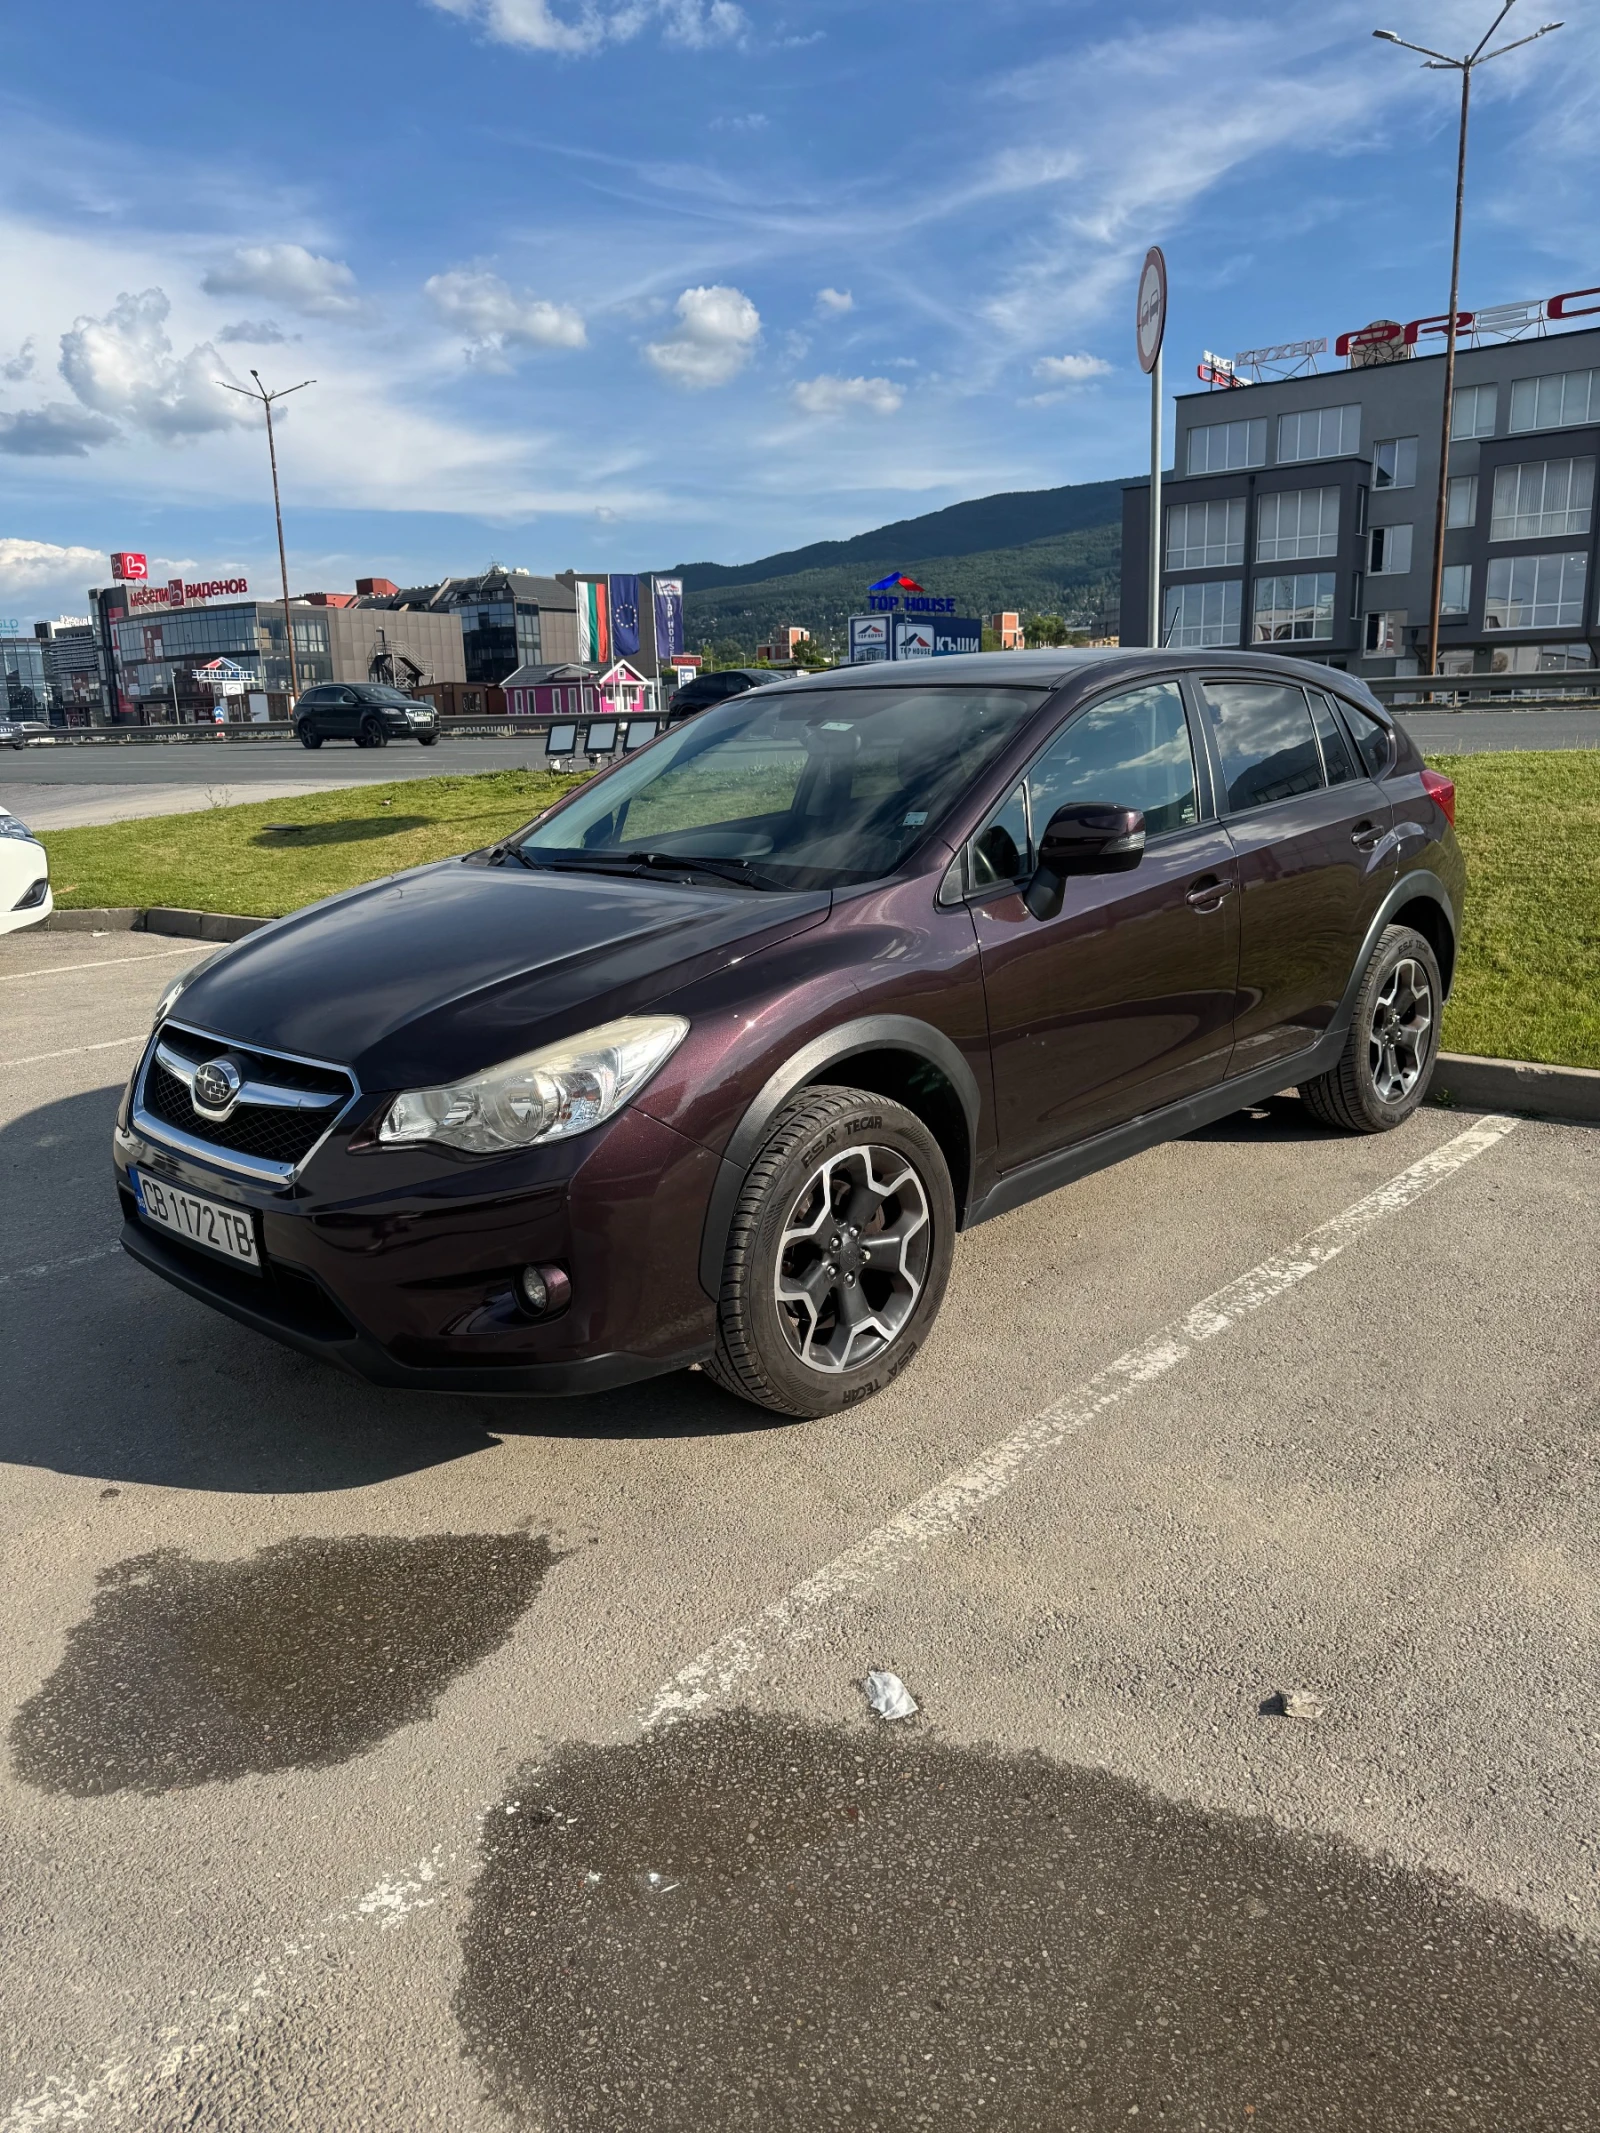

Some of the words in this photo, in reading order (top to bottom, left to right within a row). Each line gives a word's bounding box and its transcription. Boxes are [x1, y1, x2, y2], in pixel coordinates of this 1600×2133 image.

[1235, 337, 1327, 367] КУХНИ
[867, 595, 899, 611] TOP
[903, 596, 956, 613] HOUSE
[912, 647, 931, 656] HOUSE
[844, 1115, 883, 1136] TECAR
[842, 1378, 881, 1404] TECAR
